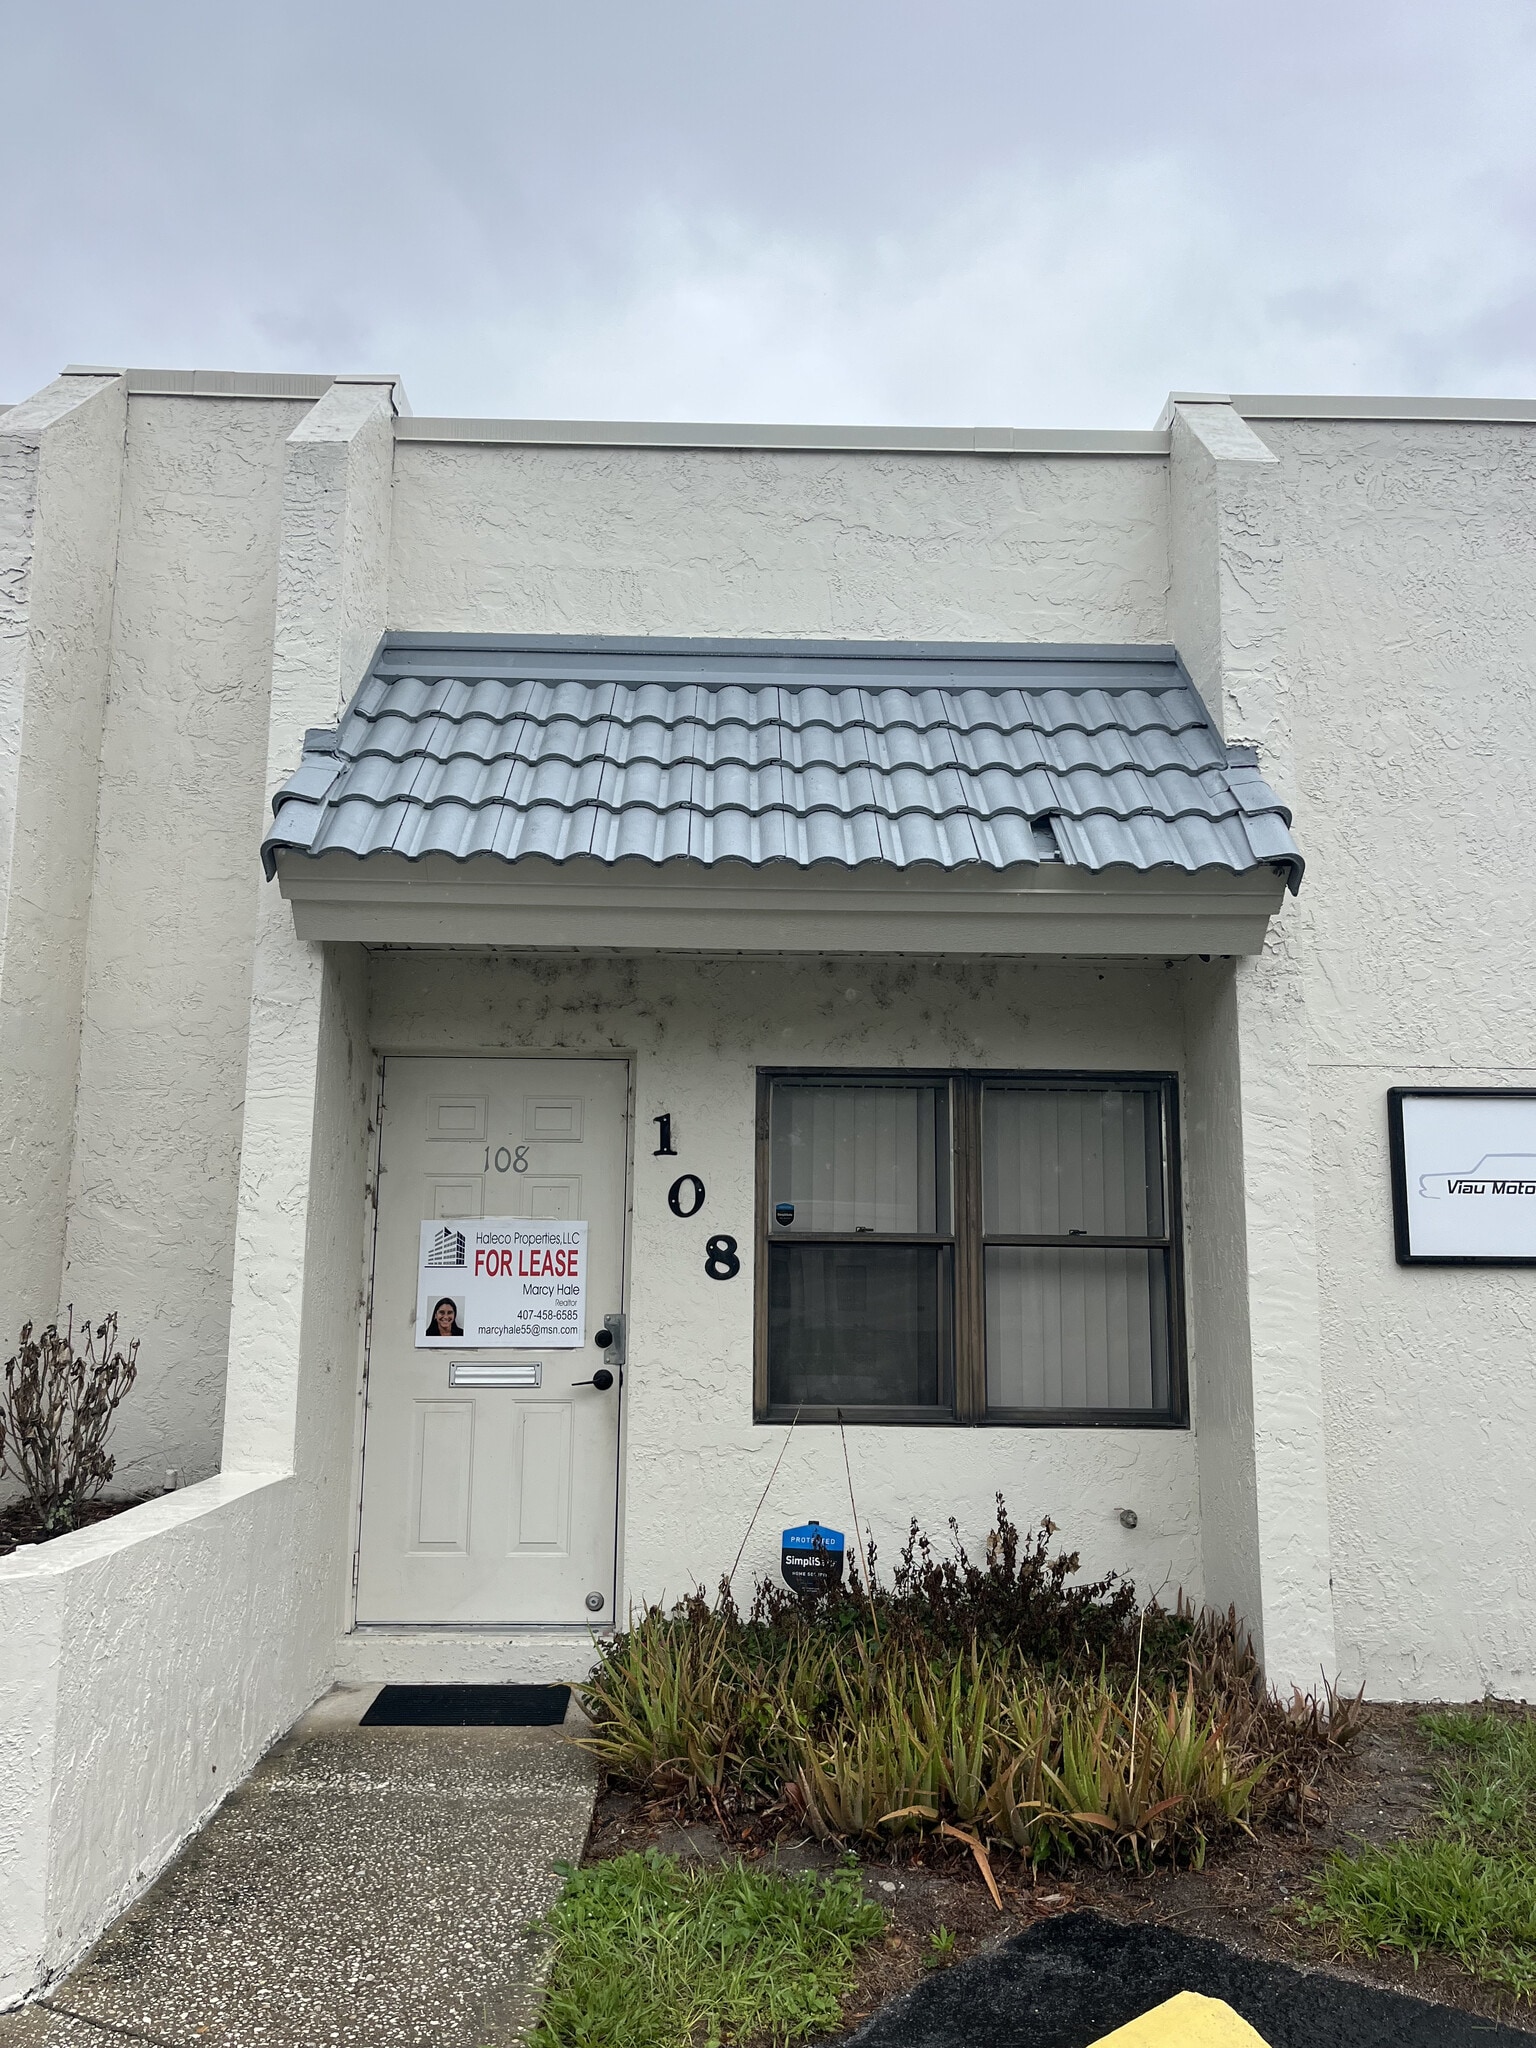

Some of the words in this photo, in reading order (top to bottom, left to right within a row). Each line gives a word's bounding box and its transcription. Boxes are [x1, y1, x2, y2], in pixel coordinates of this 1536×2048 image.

[484, 1146, 530, 1173] 108
[1447, 1180, 1485, 1194] Viau
[1492, 1180, 1536, 1195] Moto
[476, 1232, 511, 1245] Haleco
[514, 1232, 580, 1247] Properties,LLC
[474, 1249, 513, 1277] FOR
[518, 1249, 579, 1277] LEASE
[522, 1284, 554, 1298] Marcy
[557, 1284, 580, 1296] Hale
[555, 1299, 578, 1307] Realtor
[517, 1309, 578, 1320] 407-458-6585
[478, 1324, 578, 1337] marcyhale55@msn.com
[790, 1536, 836, 1545] PROTETED
[785, 1555, 837, 1568] SimpliS
